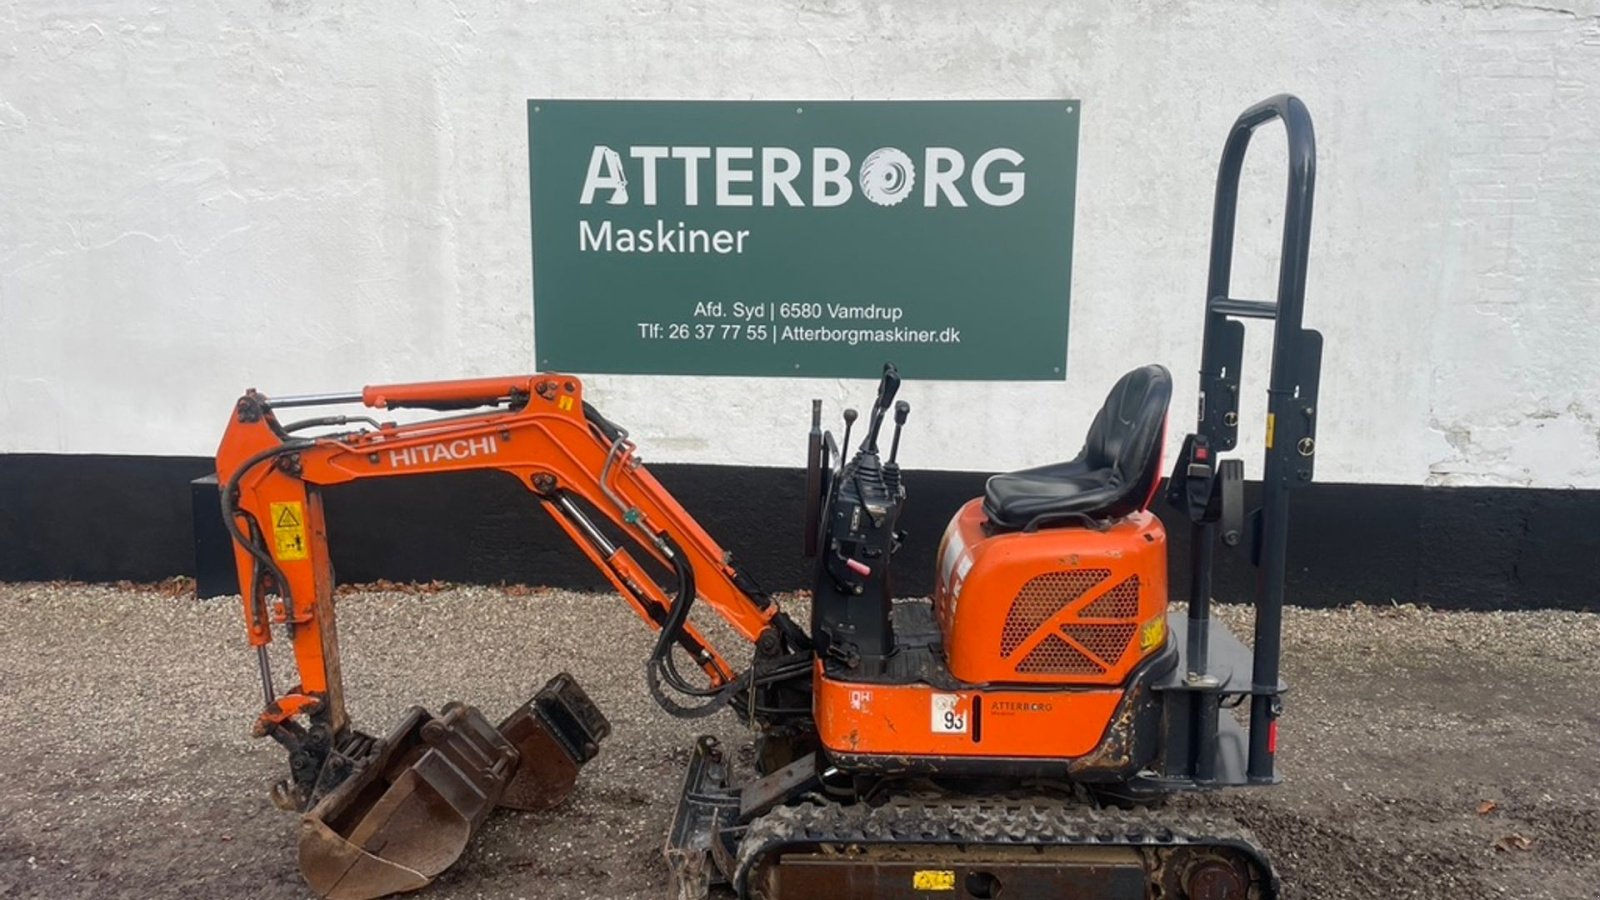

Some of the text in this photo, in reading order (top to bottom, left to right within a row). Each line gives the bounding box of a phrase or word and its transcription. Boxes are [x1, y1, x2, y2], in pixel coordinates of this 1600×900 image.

[579, 145, 1026, 208] ATTERBORG
[579, 219, 750, 254] Maskiner
[694, 301, 903, 323] Afd. Syd 6580 Vamdrup
[637, 322, 961, 346] Tlf: 26 37 77 55 Atterborgmaskiner.dk
[389, 436, 497, 468] HITACHI
